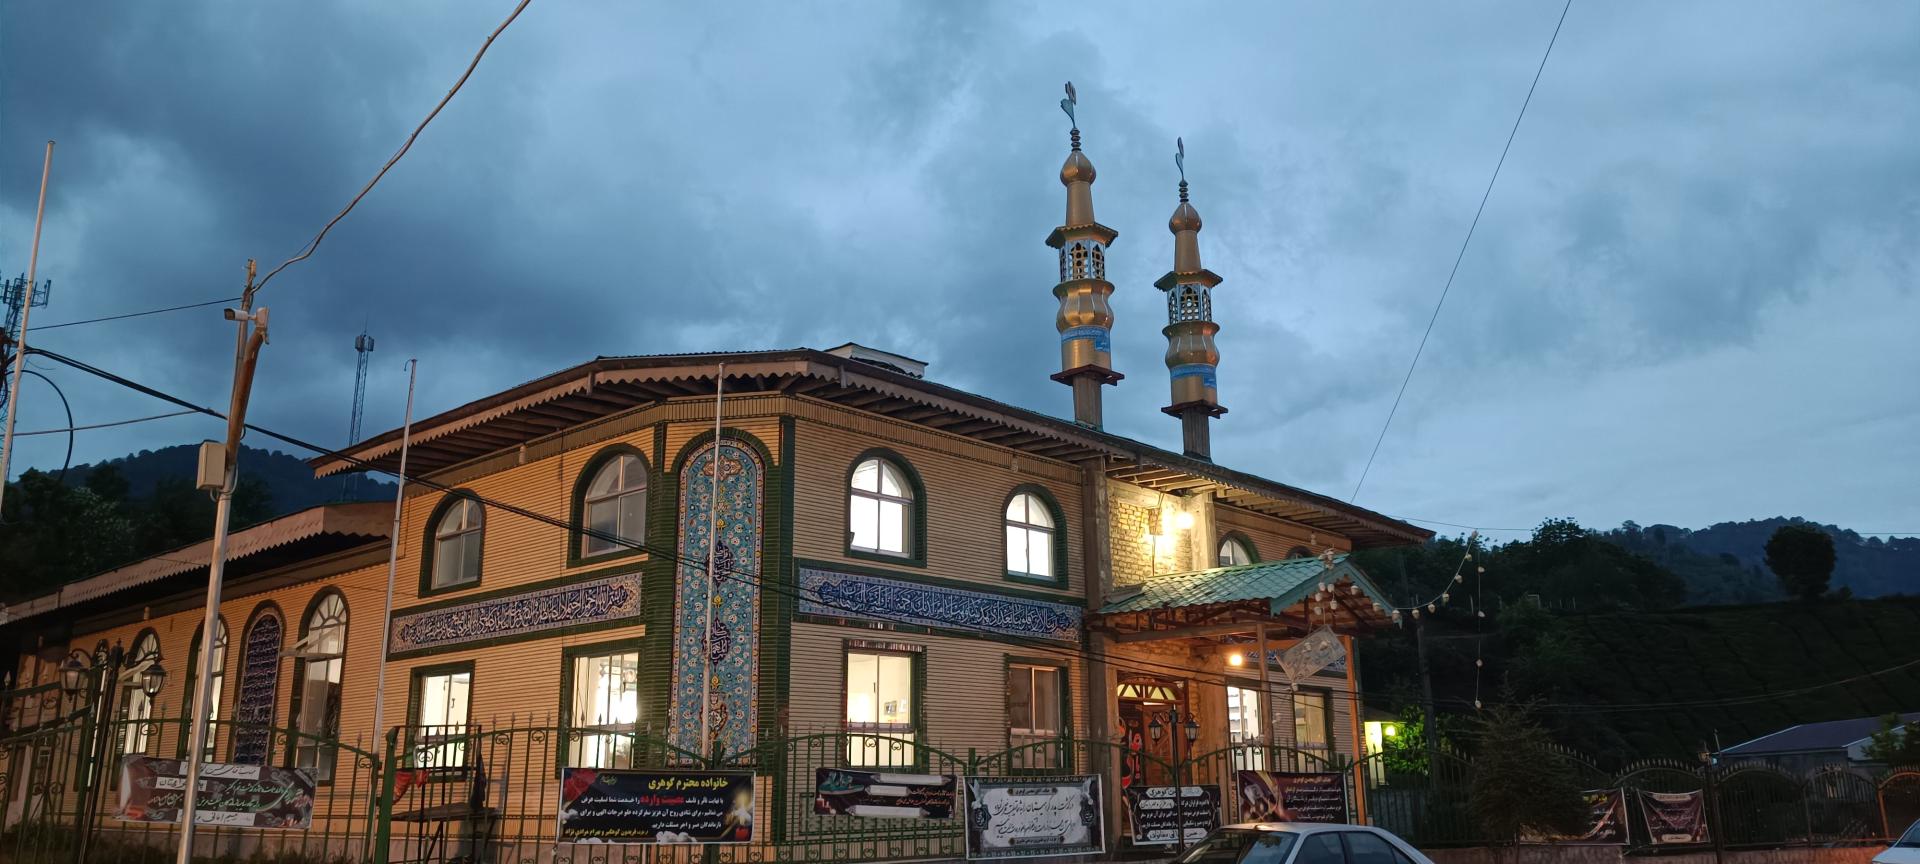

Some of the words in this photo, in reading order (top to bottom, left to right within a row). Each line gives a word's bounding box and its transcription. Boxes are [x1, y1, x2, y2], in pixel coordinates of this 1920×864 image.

[648, 776, 675, 790] گوهری
[676, 778, 699, 790] محترم
[701, 777, 728, 790] خانواده
[1148, 787, 1168, 797] گوهری
